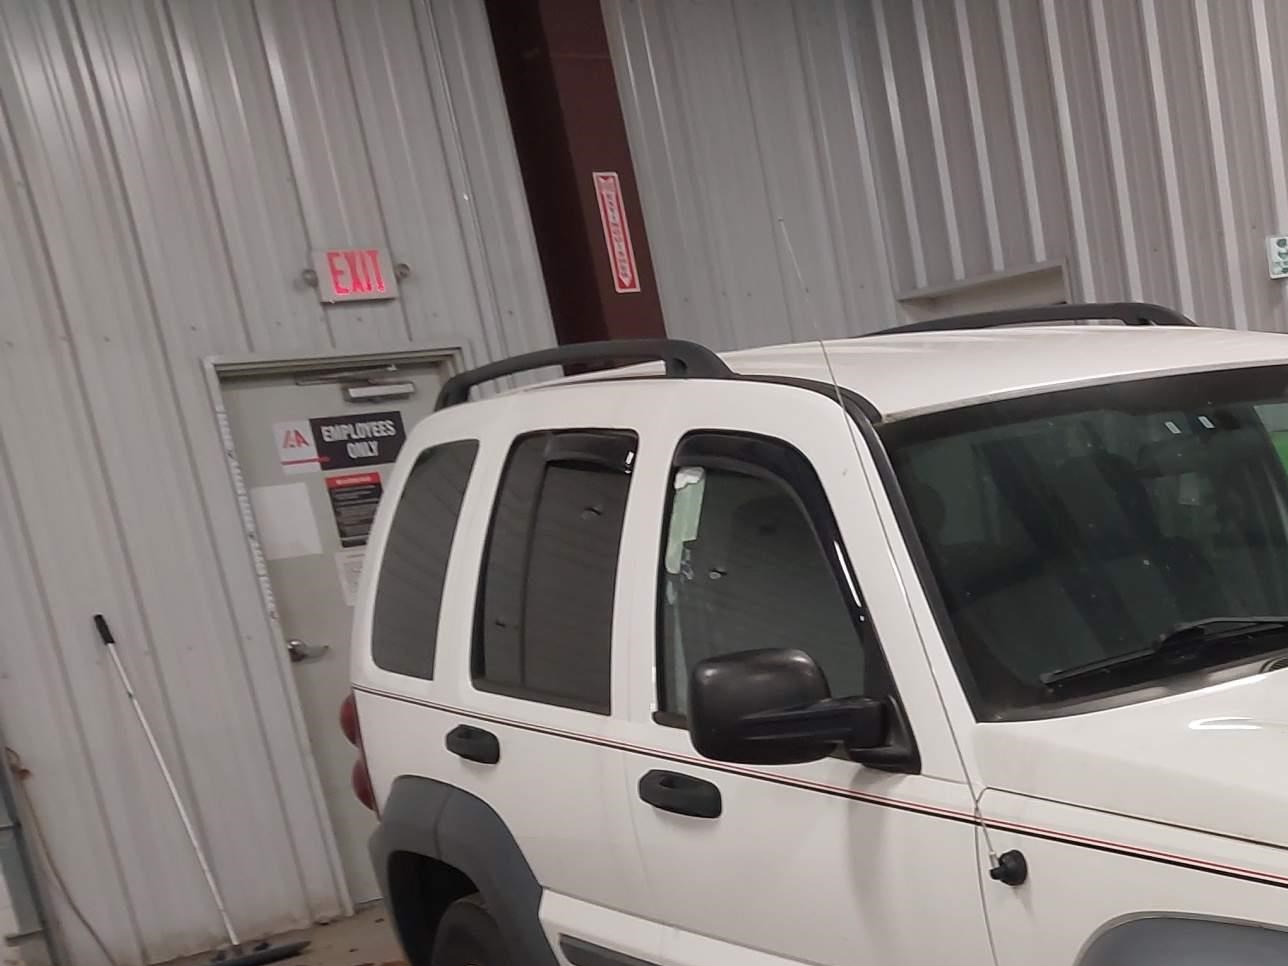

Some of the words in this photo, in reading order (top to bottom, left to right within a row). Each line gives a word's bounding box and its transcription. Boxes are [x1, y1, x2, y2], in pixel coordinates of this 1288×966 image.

[326, 250, 385, 295] EXIT
[320, 420, 397, 442] EMPLOYEES
[346, 440, 379, 458] ONLY
